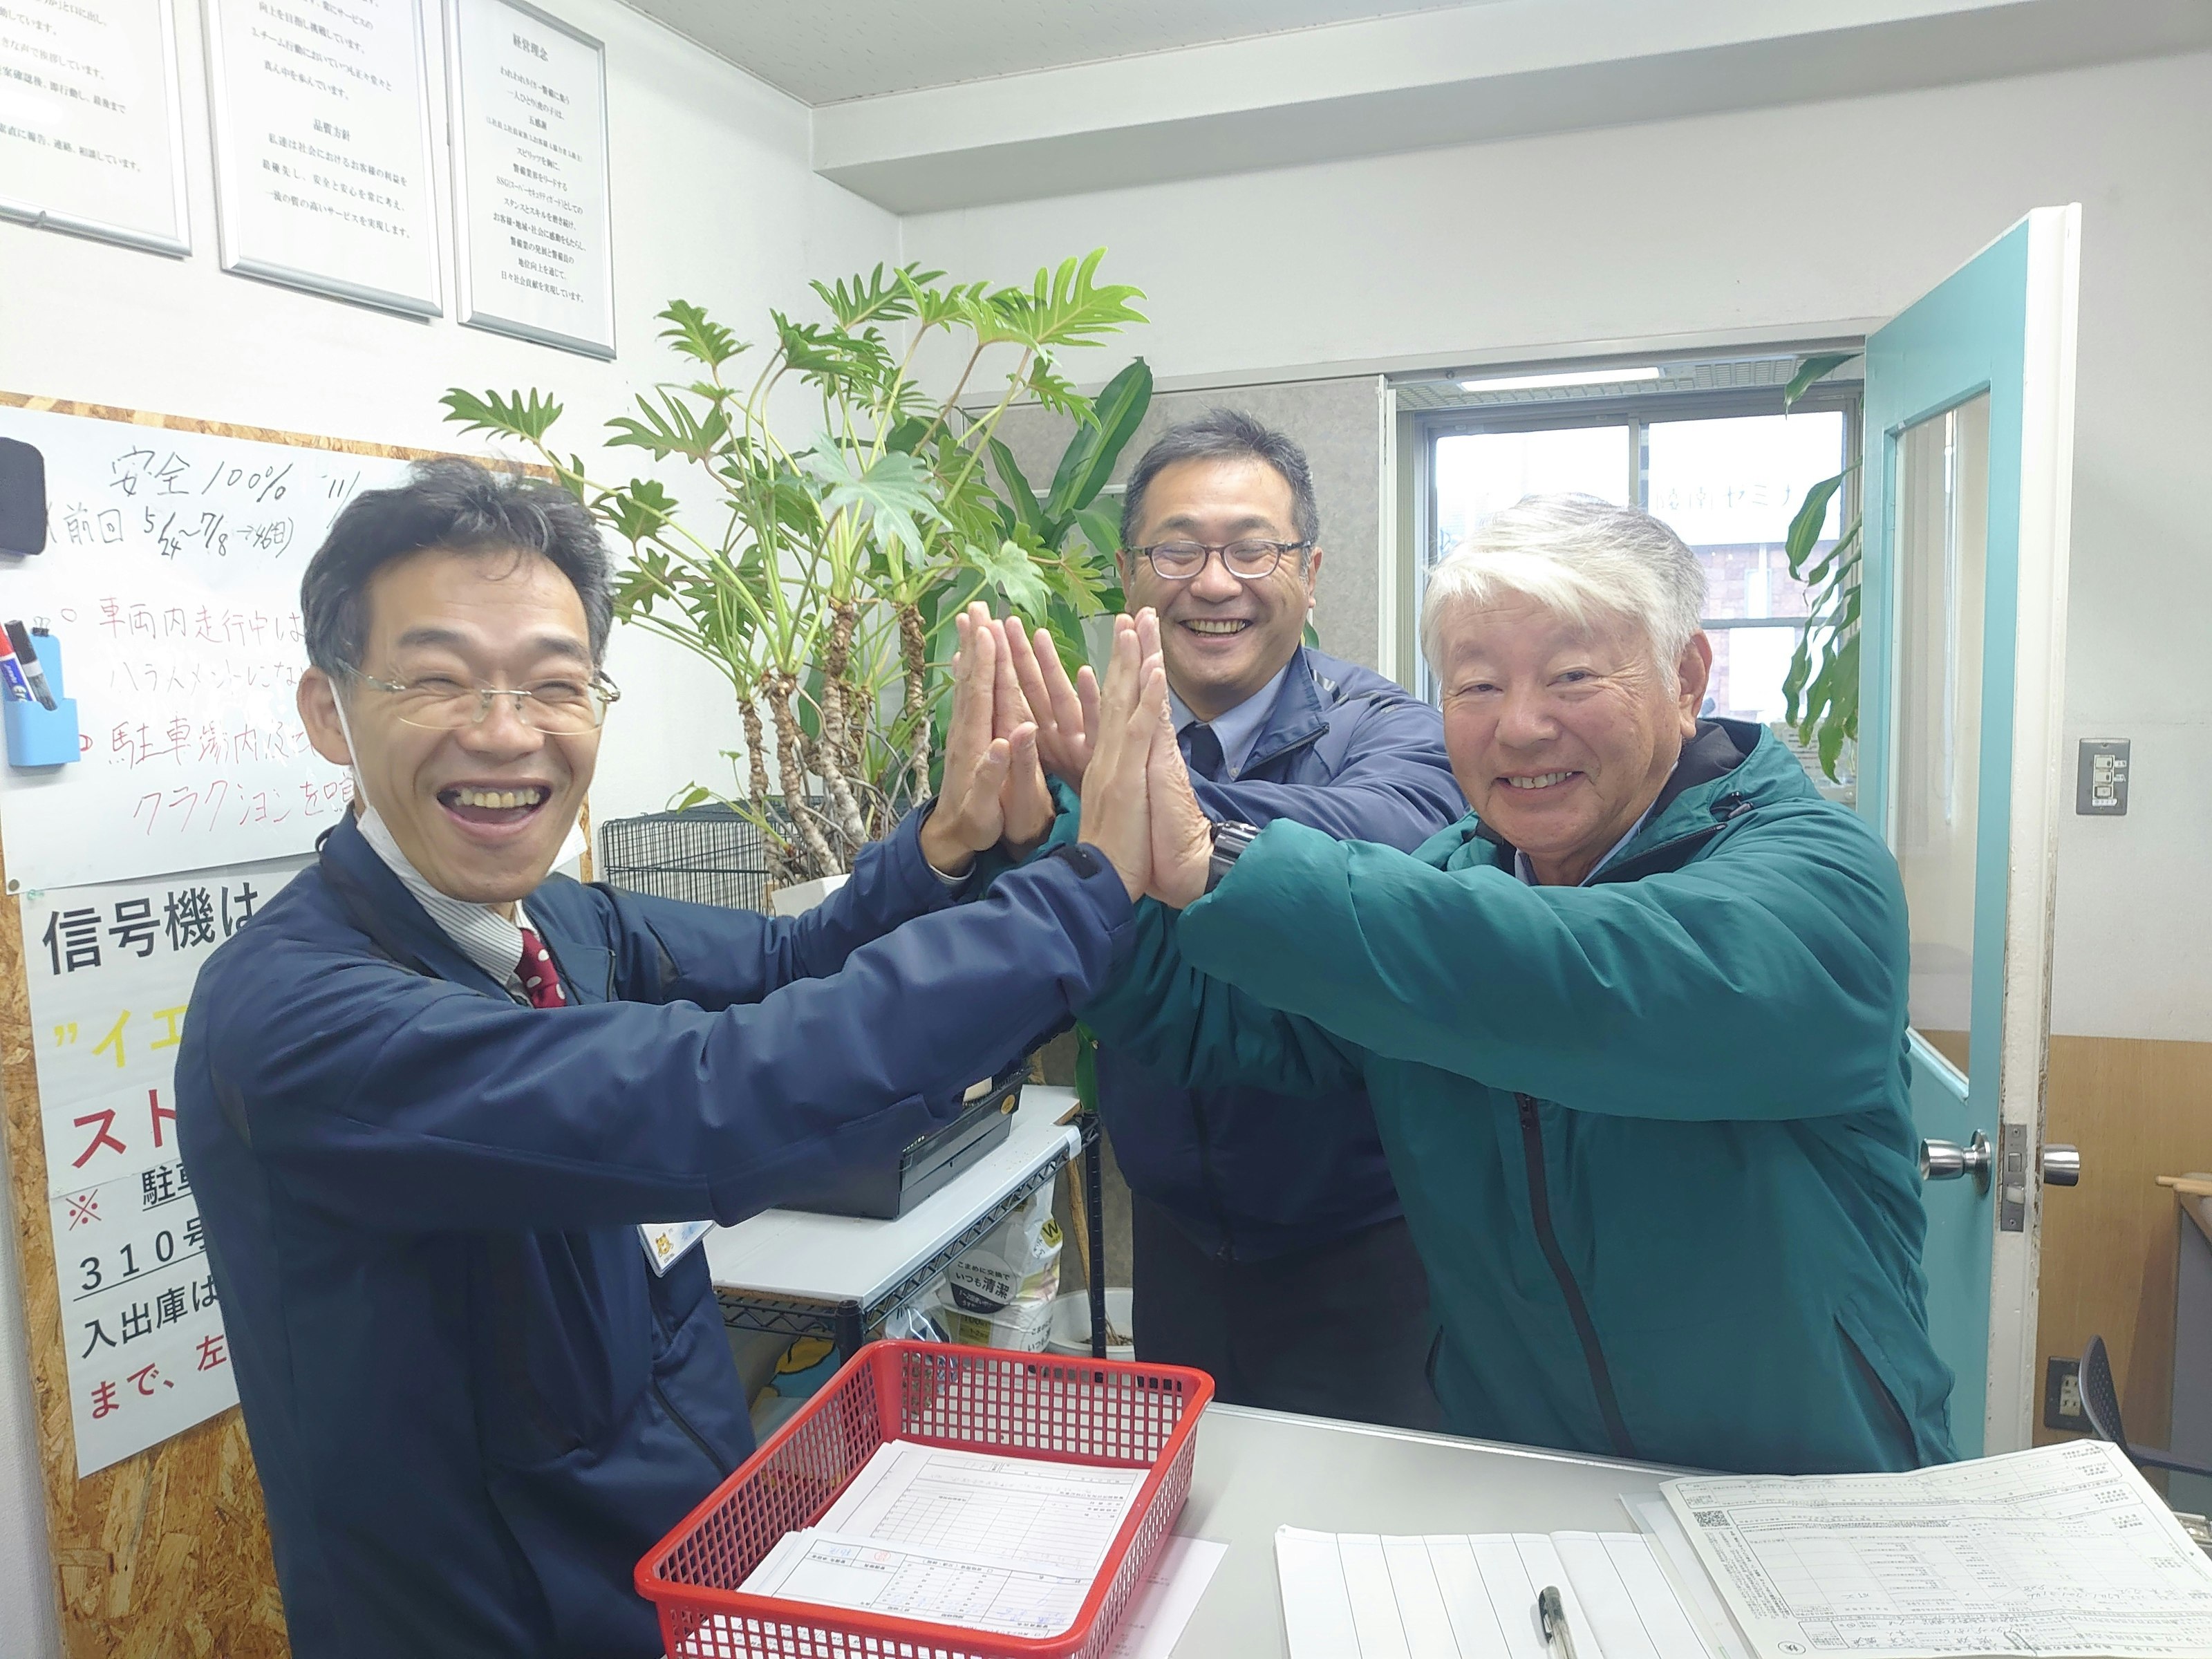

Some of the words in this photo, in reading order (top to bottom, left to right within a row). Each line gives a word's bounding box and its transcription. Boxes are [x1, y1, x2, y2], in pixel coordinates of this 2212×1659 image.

[512, 32, 549, 62] 経営理念
[313, 118, 351, 142] 品質方針
[510, 236, 574, 264] 警備業の発展と警備員の
[109, 445, 191, 497] 安全
[201, 461, 293, 503] 100%
[42, 882, 259, 975] 信号機は
[71, 1089, 176, 1168] スト
[956, 1273, 1009, 1299] いつも清潔
[82, 1275, 218, 1359] 入出庫は
[196, 1335, 227, 1371] 左
